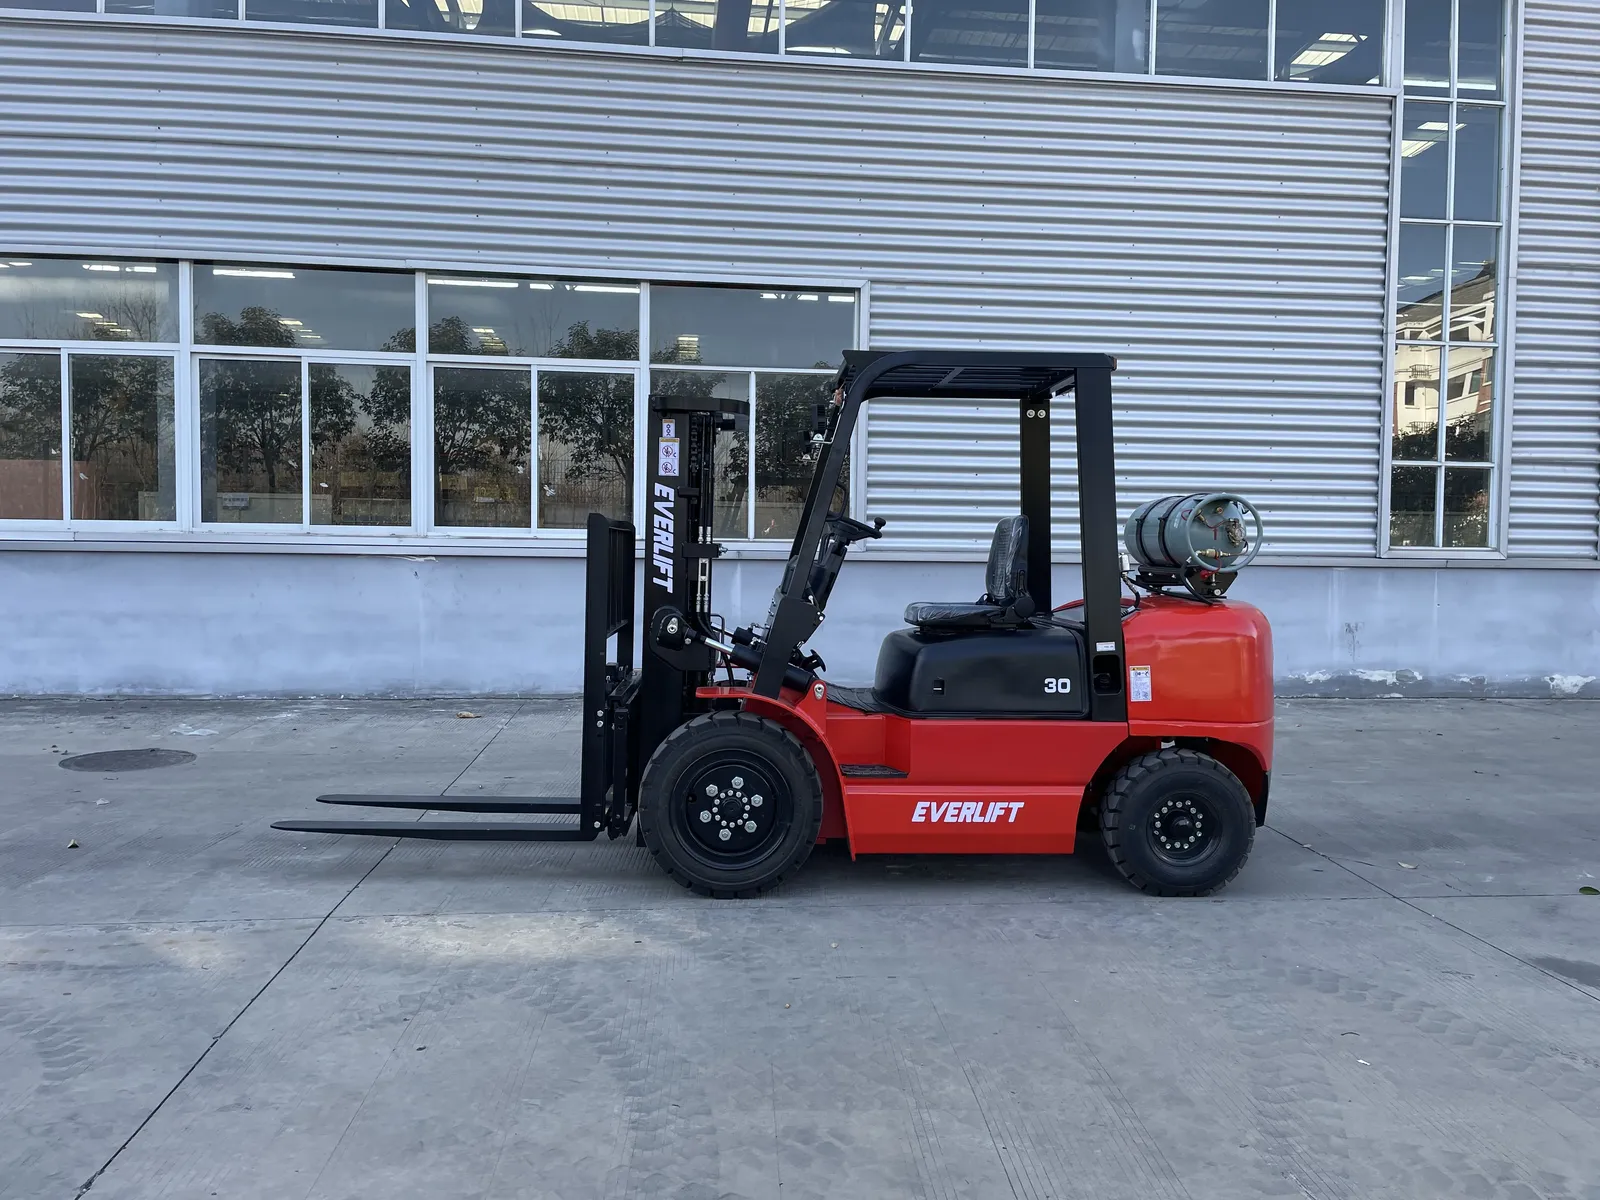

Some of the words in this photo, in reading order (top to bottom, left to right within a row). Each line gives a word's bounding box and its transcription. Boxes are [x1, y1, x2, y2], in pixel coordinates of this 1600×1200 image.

[653, 482, 675, 593] EVERLIFT
[1044, 678, 1070, 693] 30
[912, 802, 1024, 822] EVERLIFT
